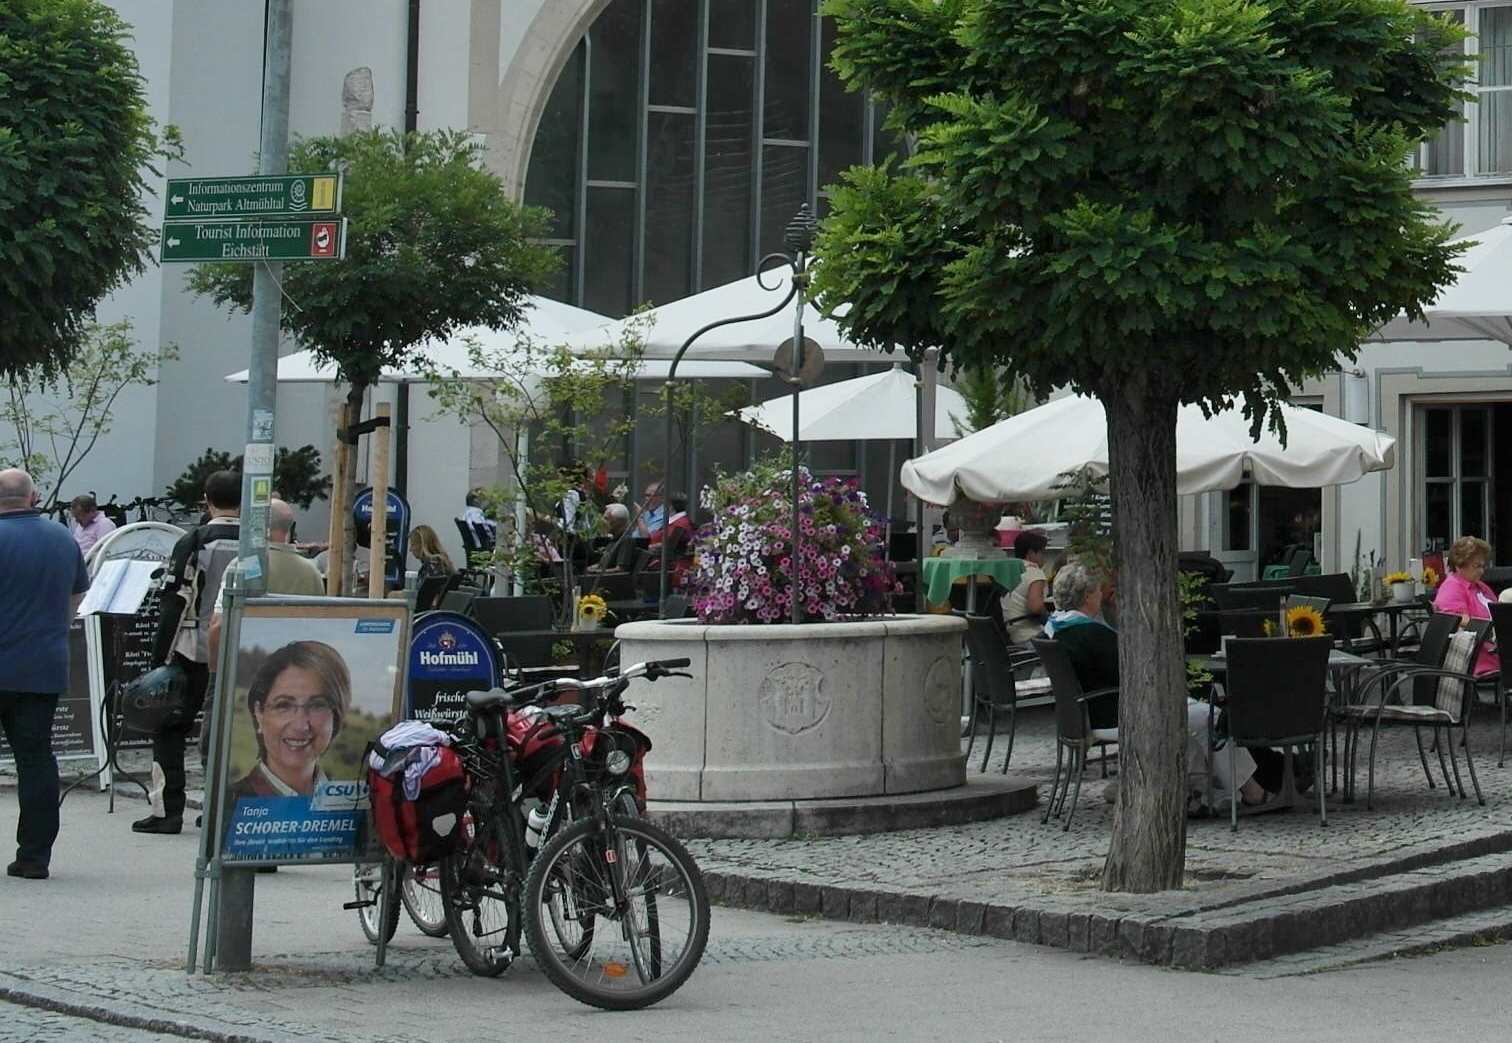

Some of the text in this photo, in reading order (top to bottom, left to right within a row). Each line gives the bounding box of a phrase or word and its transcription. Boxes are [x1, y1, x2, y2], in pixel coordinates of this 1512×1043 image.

[188, 182, 284, 195] Informationszentrum
[187, 197, 284, 215] Naturpark Altmühltal
[195, 223, 301, 239] Tourist Information
[222, 242, 270, 258] Eichstätt
[420, 651, 479, 665] Hofmühl
[434, 691, 465, 705] frische
[325, 784, 355, 797] CSU
[243, 806, 269, 818] Tanja
[235, 818, 358, 835] SCHORER-DREMEL
